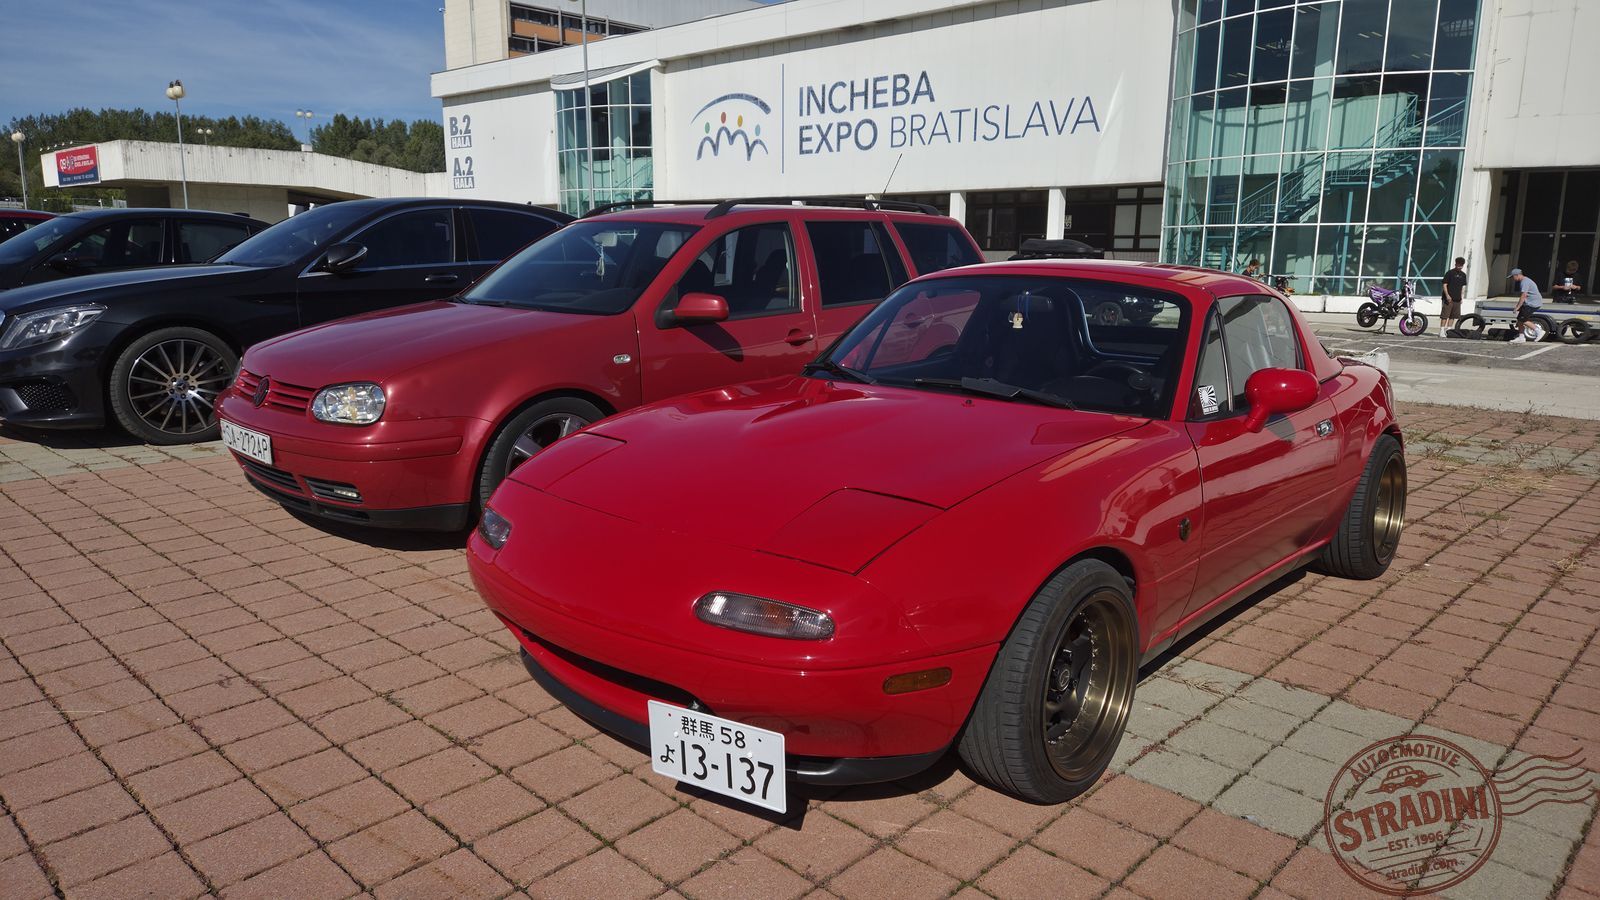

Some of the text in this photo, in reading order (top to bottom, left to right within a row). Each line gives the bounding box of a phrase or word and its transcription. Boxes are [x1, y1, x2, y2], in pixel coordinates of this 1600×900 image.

[799, 70, 935, 117] INCHEBA
[449, 114, 471, 136] B.2
[799, 96, 1101, 155] EXPO BRATISLAVA
[451, 135, 472, 149] HALA
[453, 156, 474, 177] A.2
[454, 176, 474, 189] HALA
[681, 715, 746, 749] 群馬 58
[660, 739, 774, 800] よ 13-137
